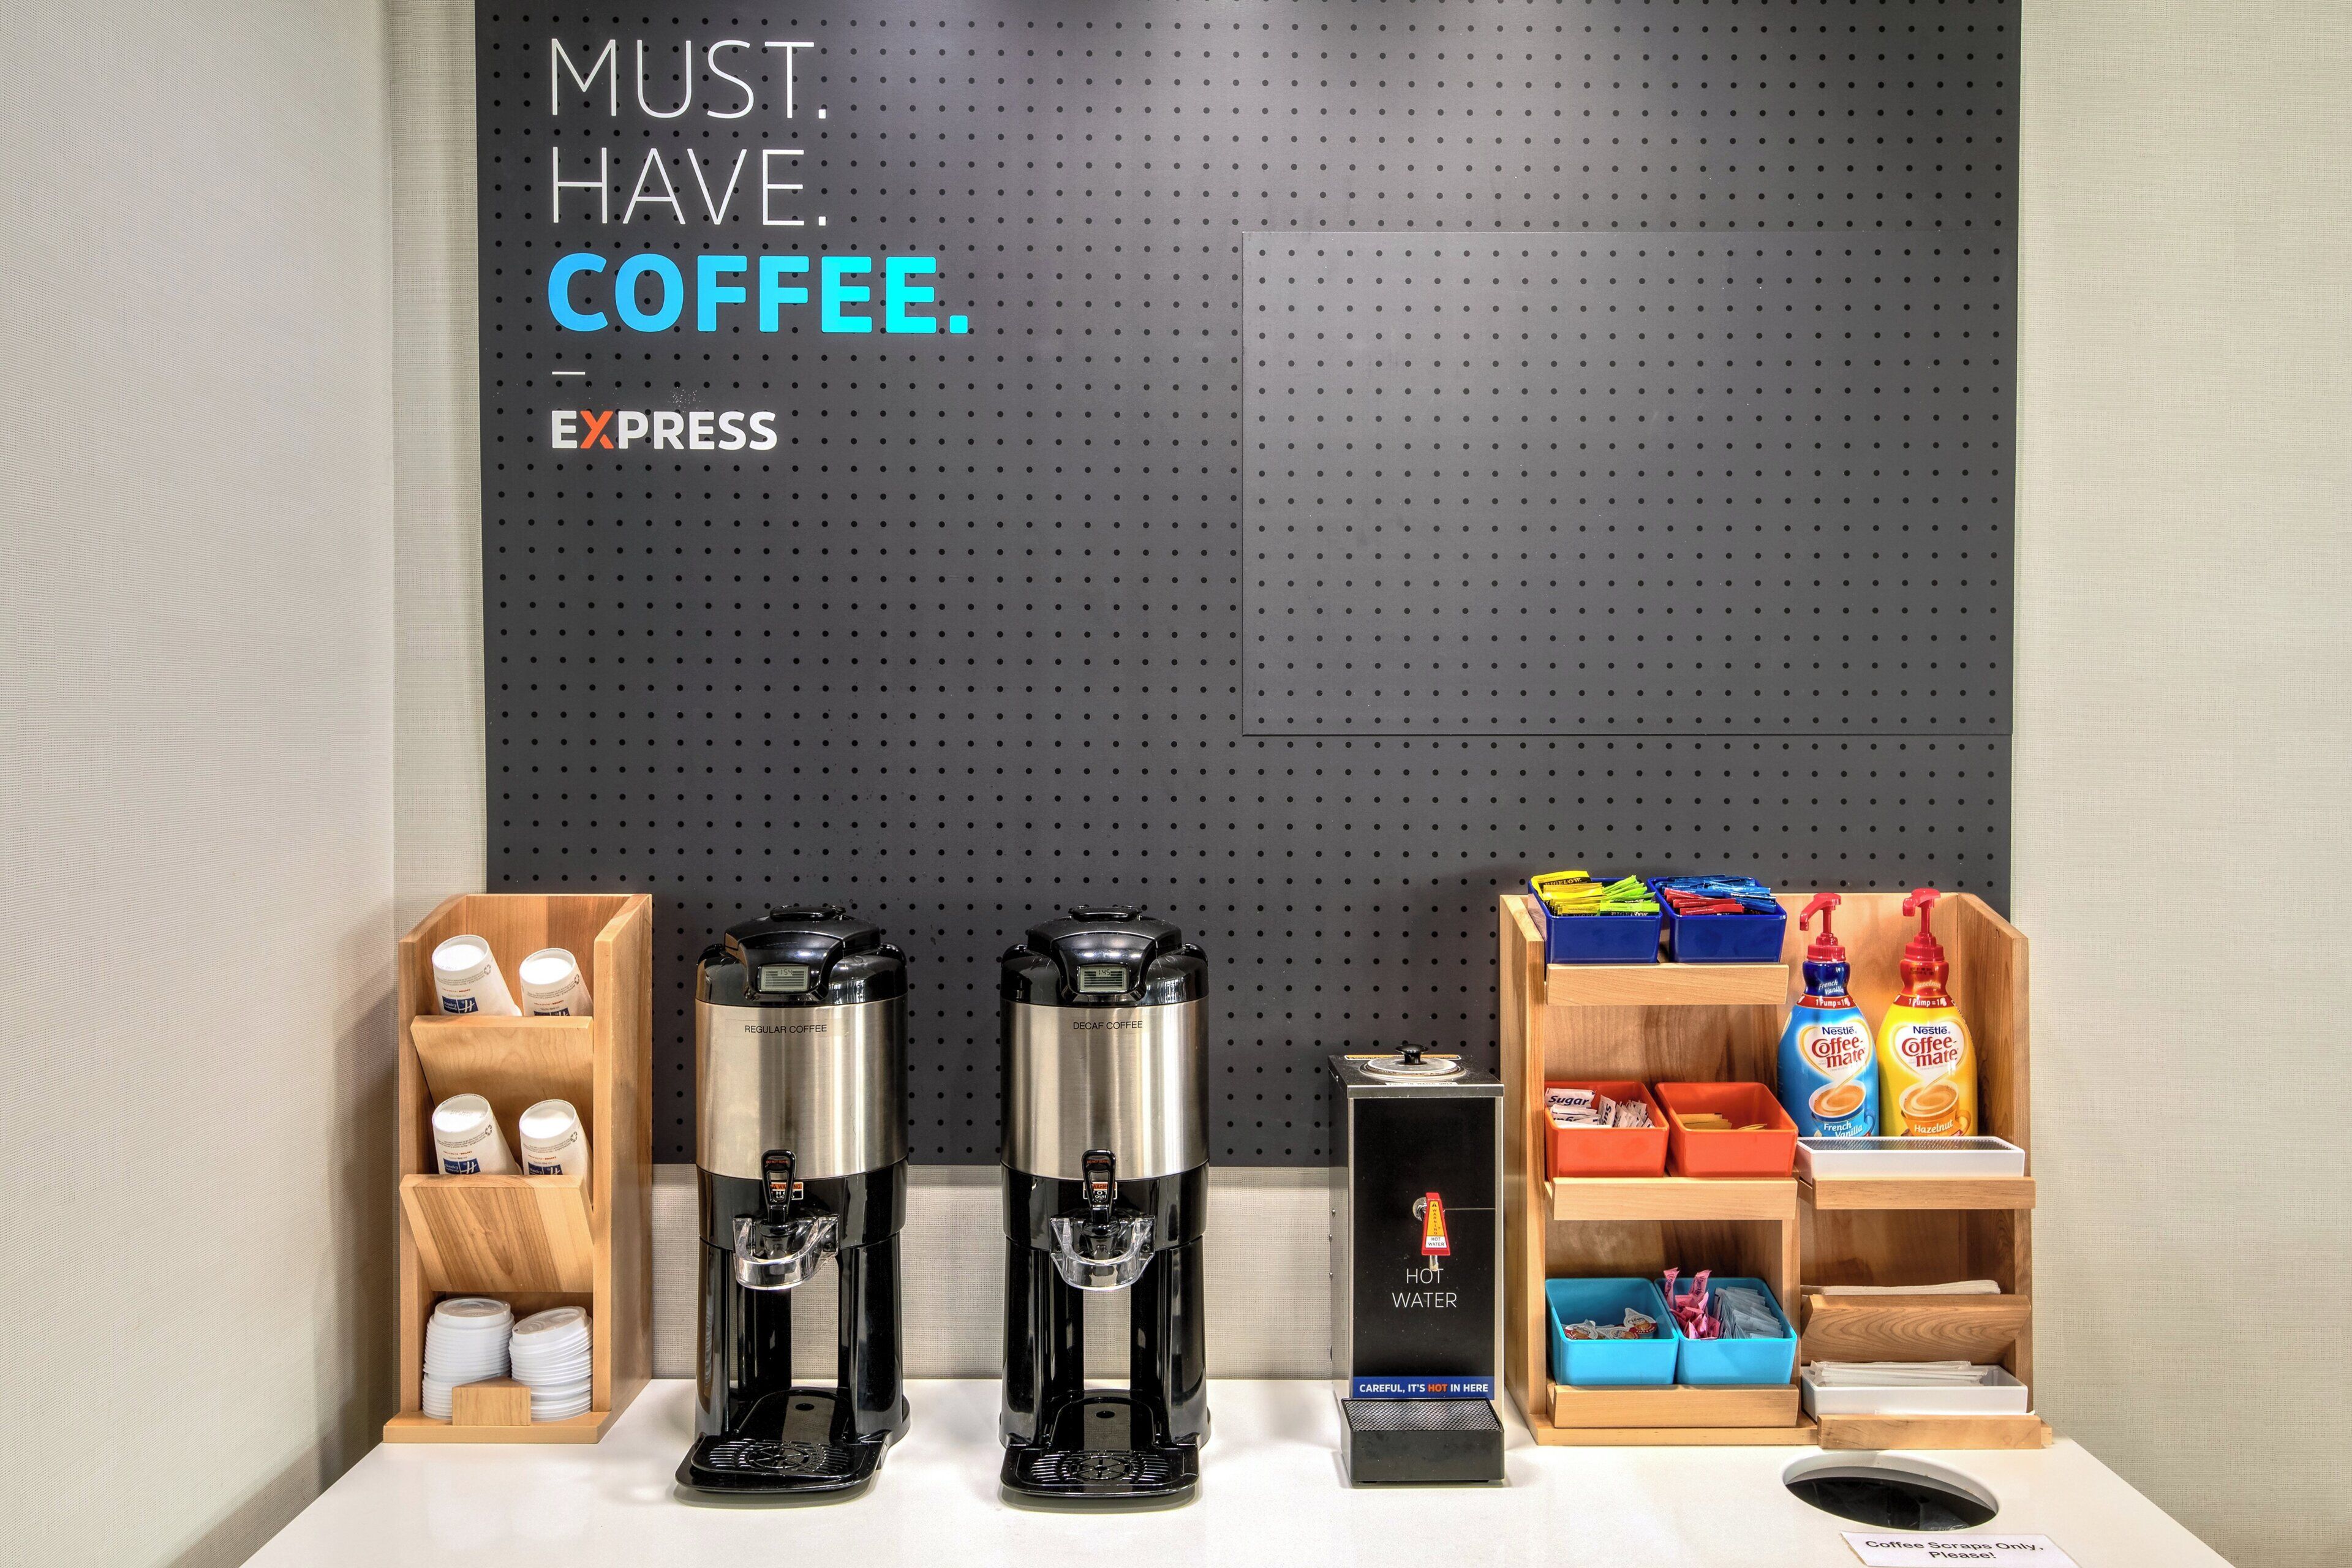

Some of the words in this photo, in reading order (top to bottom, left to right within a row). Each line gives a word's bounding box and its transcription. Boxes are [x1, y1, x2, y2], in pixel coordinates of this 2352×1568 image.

[551, 38, 826, 119] MUST.
[552, 146, 826, 225] HAVE.
[548, 252, 968, 334] COFFEE.
[552, 410, 777, 450] EXPRESS
[1819, 979, 1838, 990] French
[1825, 986, 1844, 995] Vanilla
[745, 1025, 786, 1033] REGULAR
[789, 1024, 827, 1033] COFFEE
[1106, 1020, 1143, 1030] COFFEE
[1822, 1026, 1854, 1035] Nestlé
[1913, 1026, 1947, 1035] Nestlé
[1826, 1049, 1864, 1068] mate
[1916, 1049, 1958, 1067] mate
[1548, 1095, 1589, 1106] Sugar
[1823, 1121, 1852, 1131] French
[1835, 1125, 1863, 1137] Vanilla
[1914, 1119, 1953, 1134] Hazelnut
[1406, 1268, 1444, 1284] HOT
[1392, 1292, 1457, 1308] WATER
[1359, 1384, 1405, 1393] CAREFUL,
[1428, 1384, 1448, 1392] HOT
[1866, 1540, 1924, 1549] Coffee
[1928, 1542, 1992, 1550] Scraps
[1996, 1542, 2043, 1551] Only,
